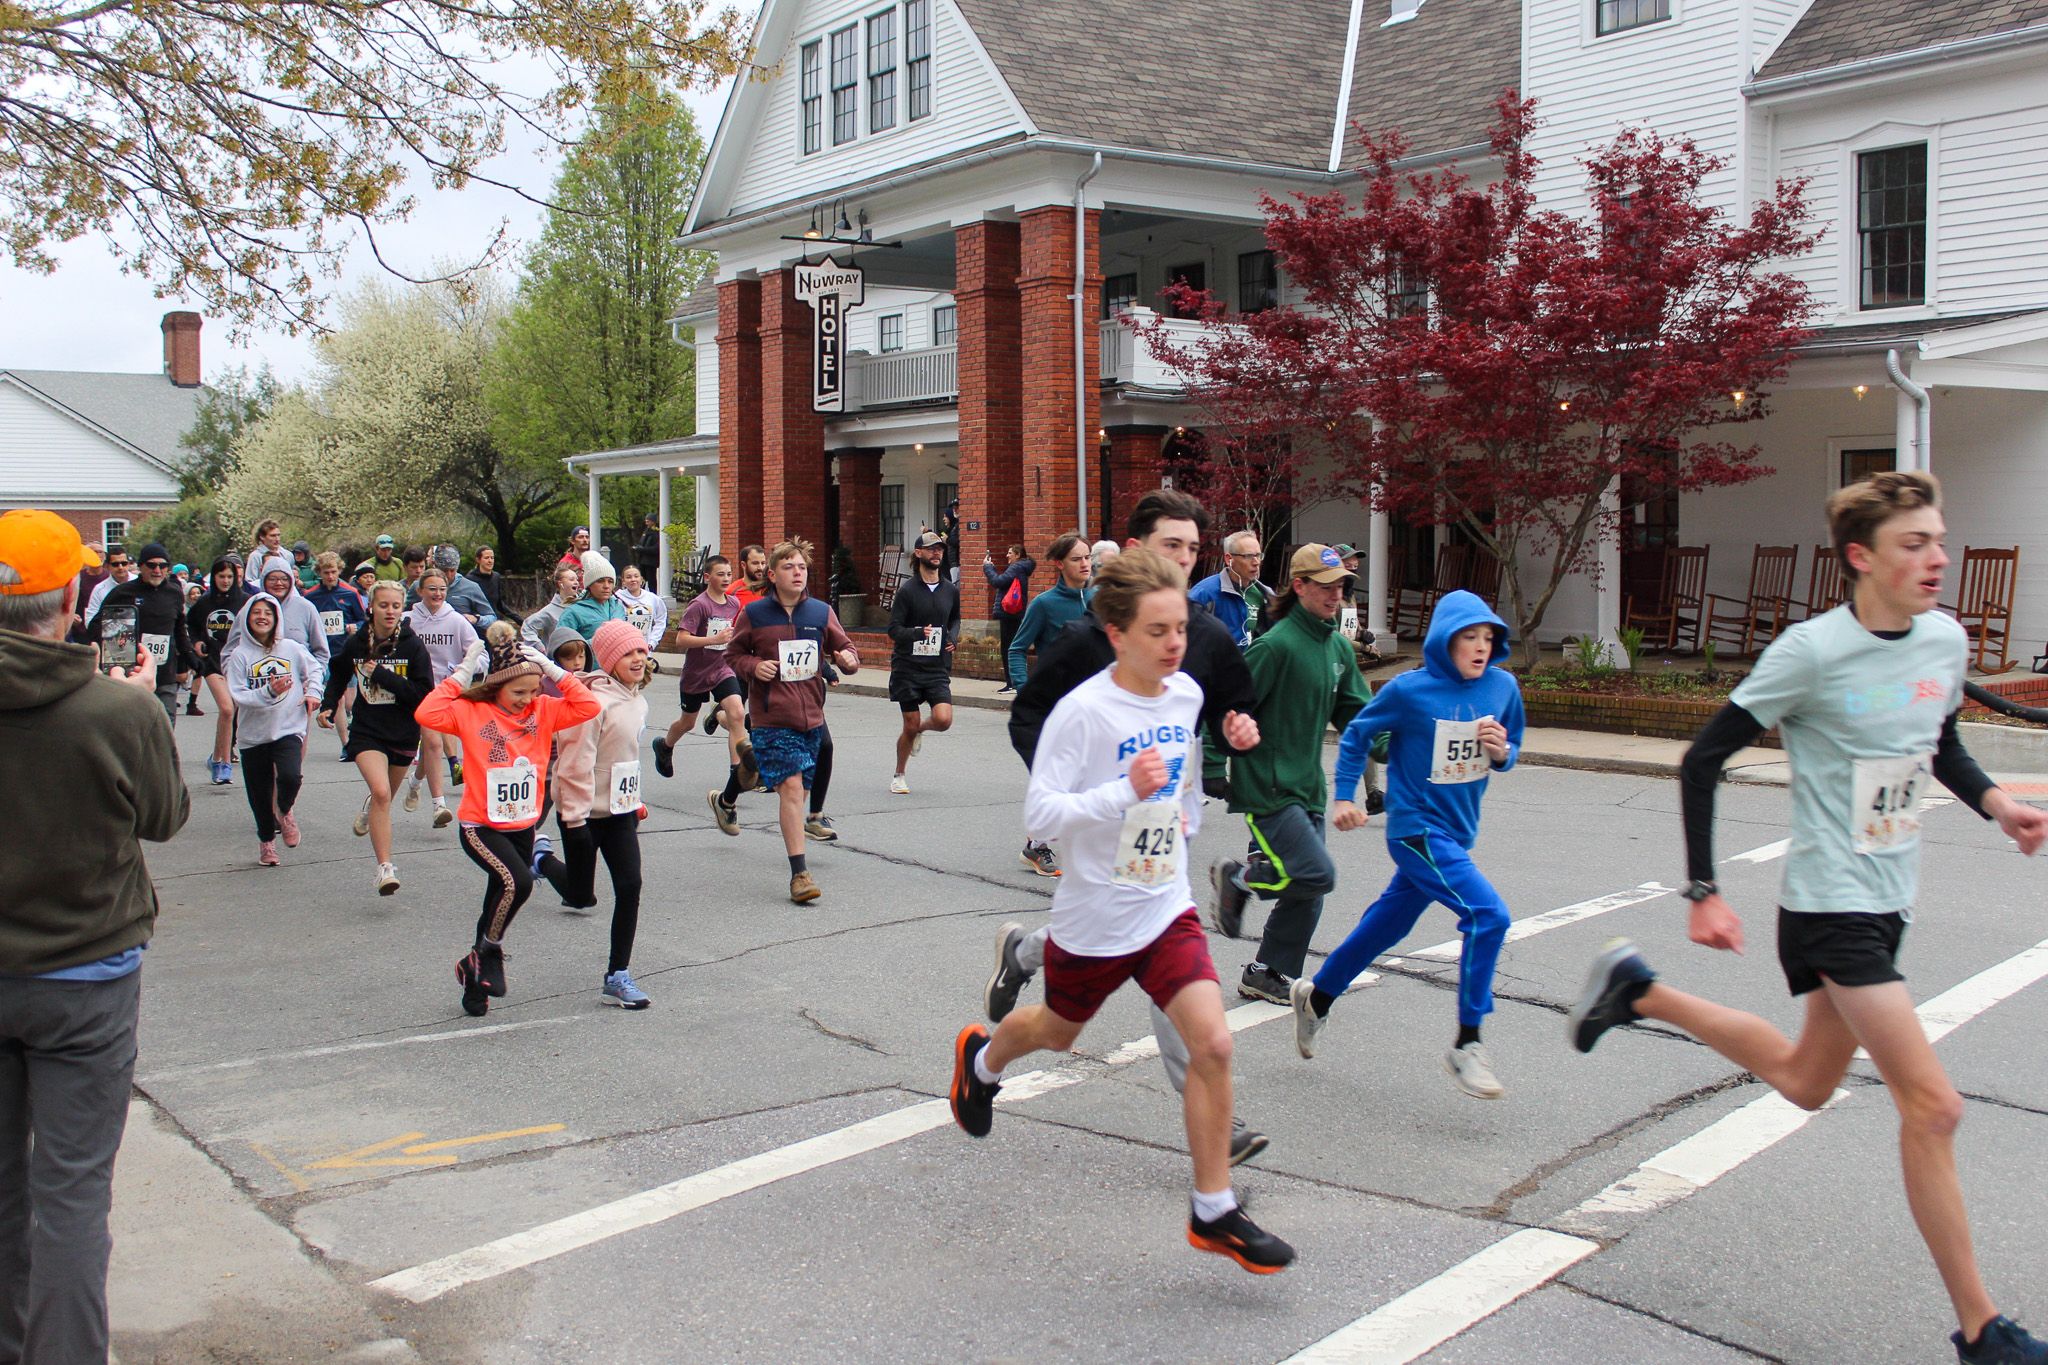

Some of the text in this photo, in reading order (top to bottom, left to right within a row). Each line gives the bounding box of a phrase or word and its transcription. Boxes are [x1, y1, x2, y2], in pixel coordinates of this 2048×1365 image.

[821, 298, 837, 390] HOTEL
[324, 617, 340, 627] 430
[147, 642, 166, 655] 398
[787, 651, 812, 667] 477
[1447, 739, 1483, 761] 551
[497, 781, 530, 803] 500
[1133, 827, 1175, 857] 429
